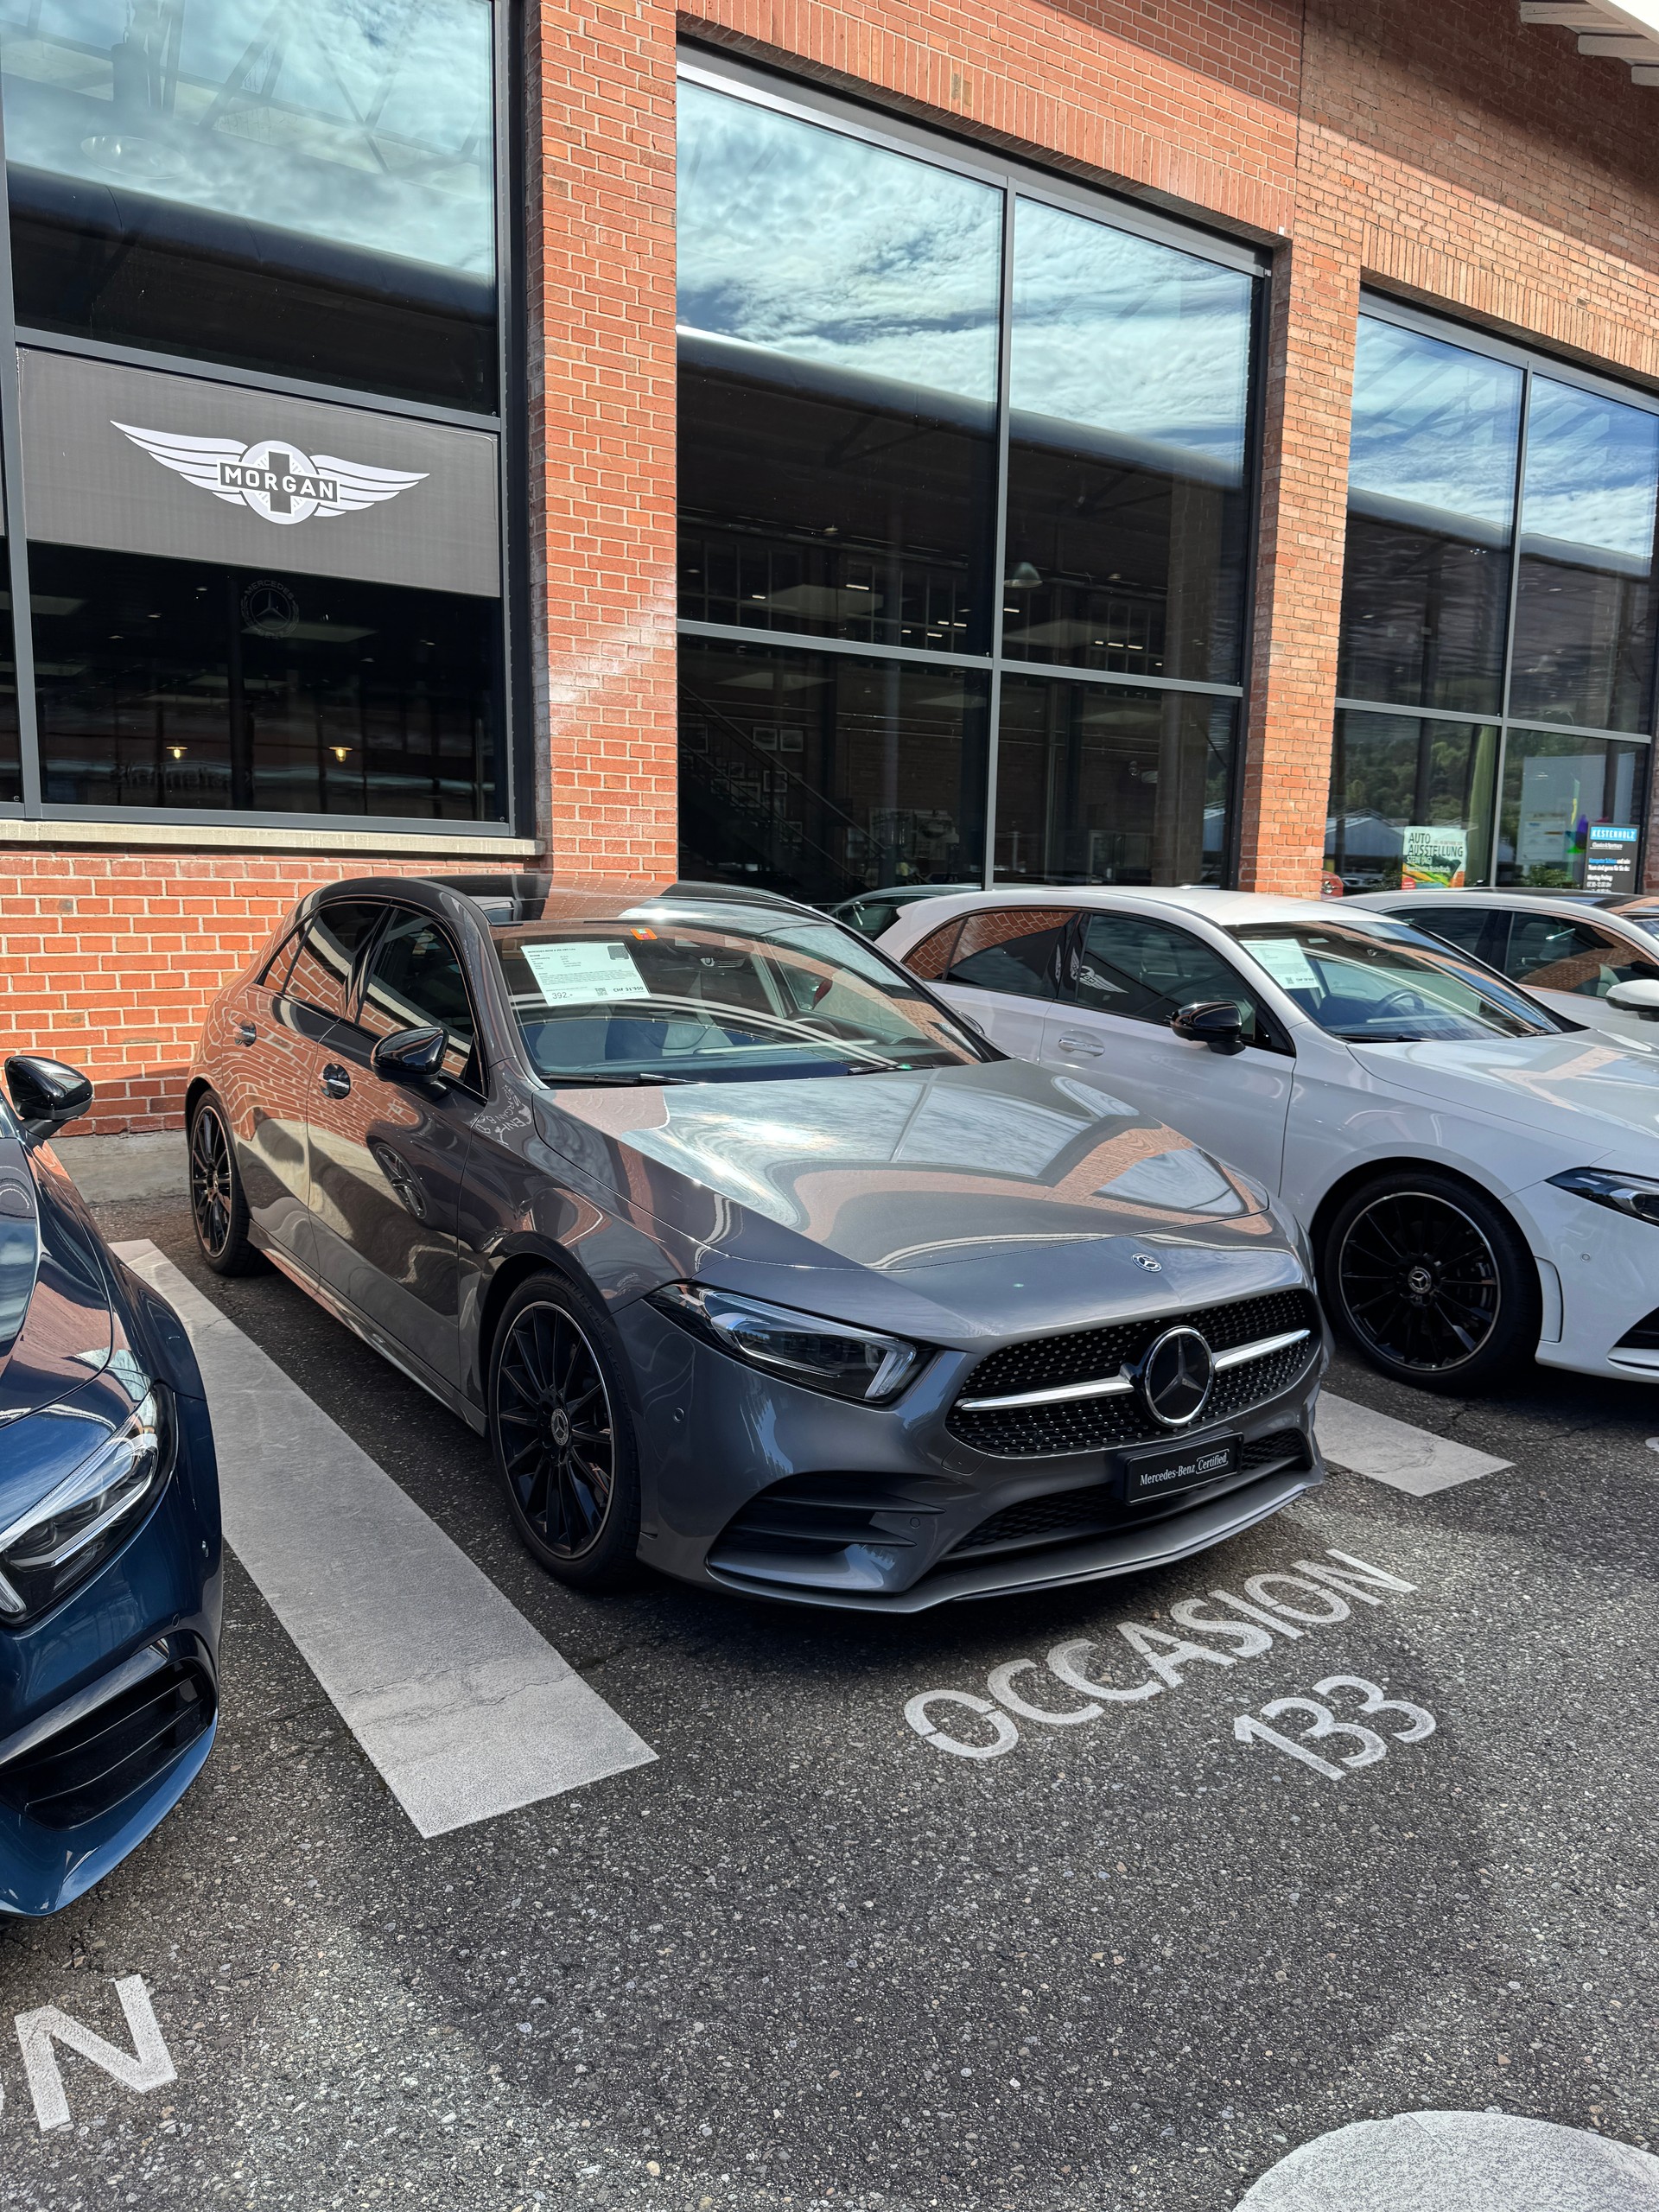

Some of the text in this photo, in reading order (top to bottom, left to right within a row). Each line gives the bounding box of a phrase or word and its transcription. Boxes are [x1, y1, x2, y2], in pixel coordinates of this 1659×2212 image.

[223, 466, 337, 500] MORGAN
[1408, 833, 1431, 844] AUTO
[1408, 844, 1464, 857] AUSSTELLUNG
[1592, 829, 1636, 840] KESTENHOLZ
[1140, 1452, 1228, 1486] Mercedes-Benz Certified
[904, 1548, 1419, 1759] OCCASION
[1233, 1675, 1436, 1781] 133
[0, 1974, 178, 2132] N
